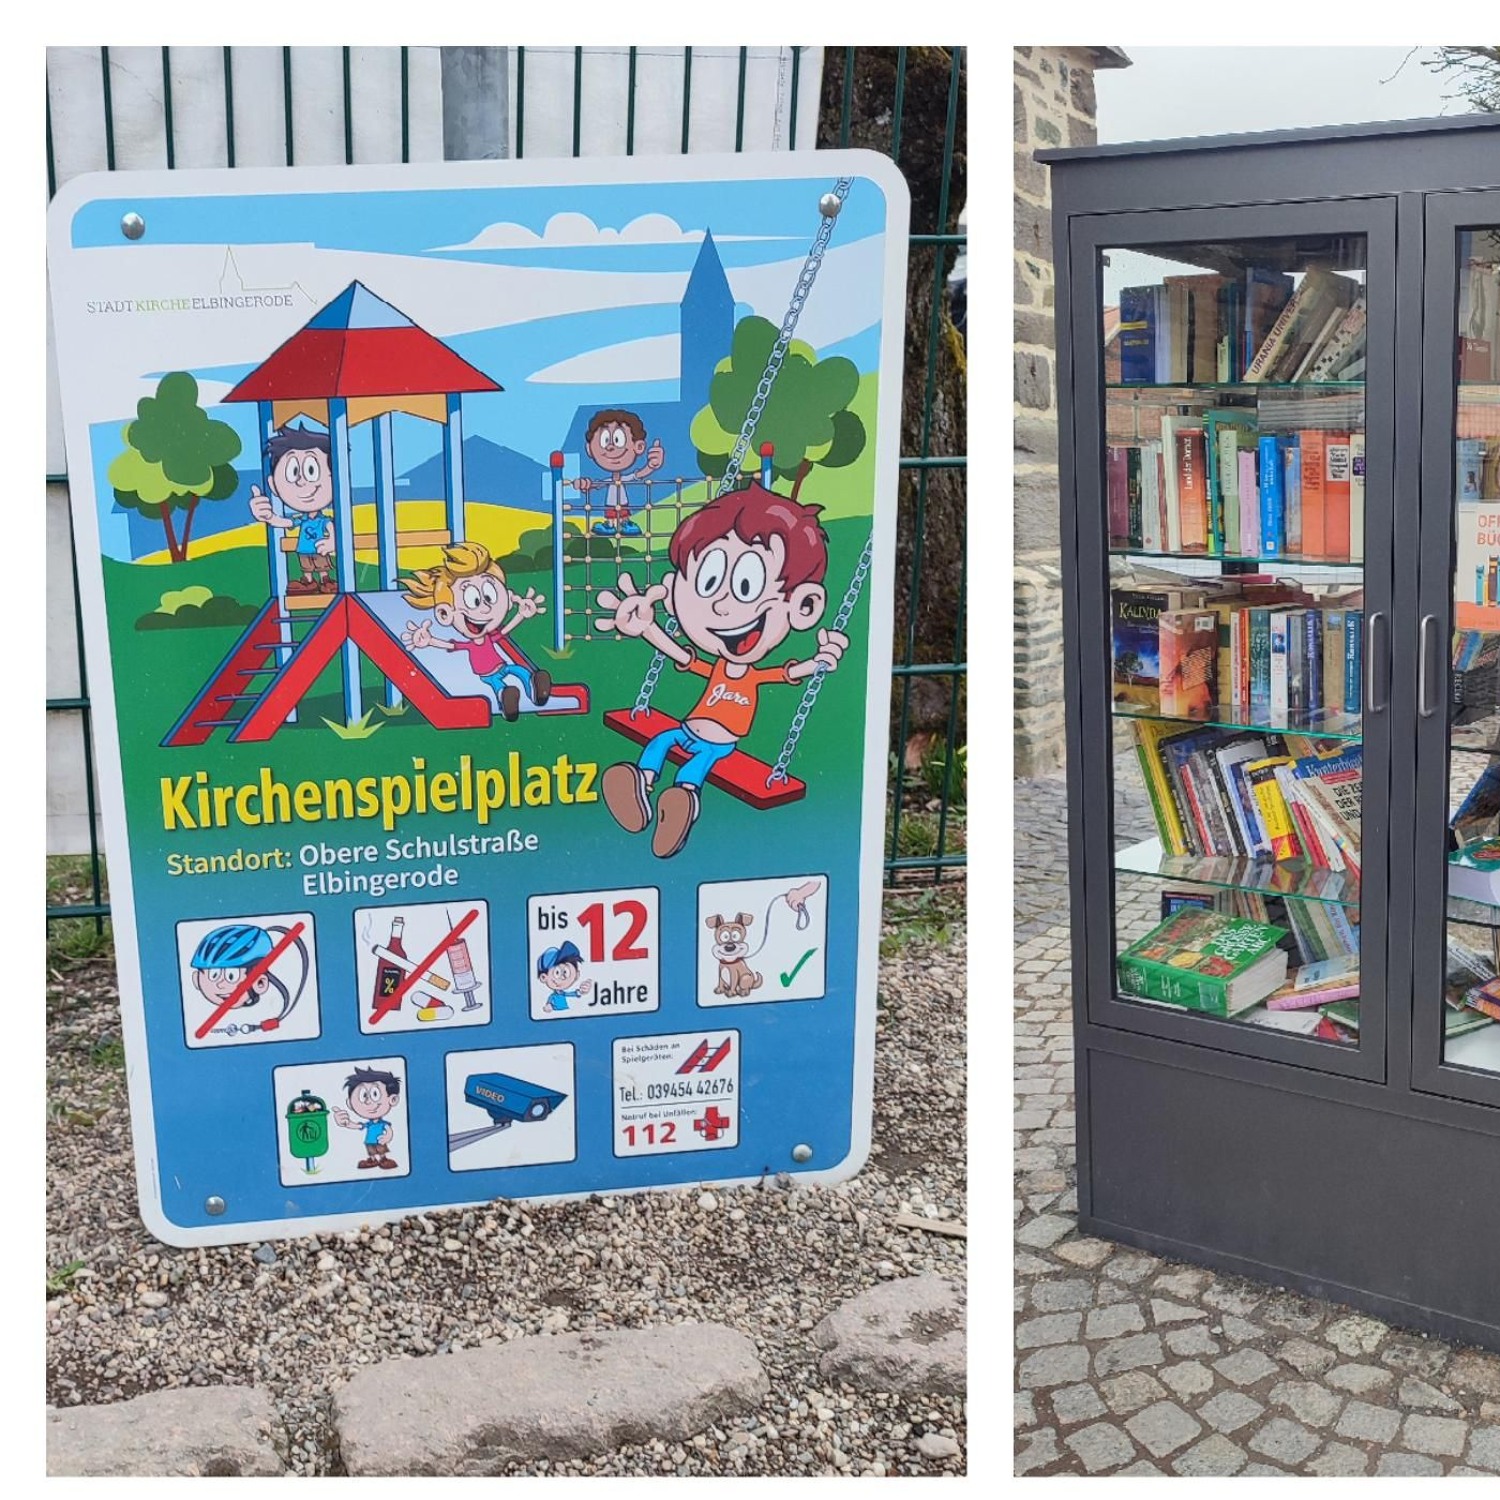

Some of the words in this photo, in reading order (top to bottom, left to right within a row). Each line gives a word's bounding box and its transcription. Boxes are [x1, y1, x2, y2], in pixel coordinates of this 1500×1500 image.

[159, 751, 599, 831] Kirchenspielplatz
[167, 847, 293, 876] Standort:
[299, 837, 379, 868] Obere
[385, 829, 540, 862] Schulstraße
[302, 864, 459, 897] Elbingerode
[538, 905, 569, 931] bis
[576, 900, 649, 963] 12
[588, 980, 649, 1007] Jahre
[475, 1085, 505, 1103] VIDEO
[647, 1081, 693, 1100] 039454
[696, 1078, 734, 1095] 42676
[622, 1121, 677, 1147] 112
